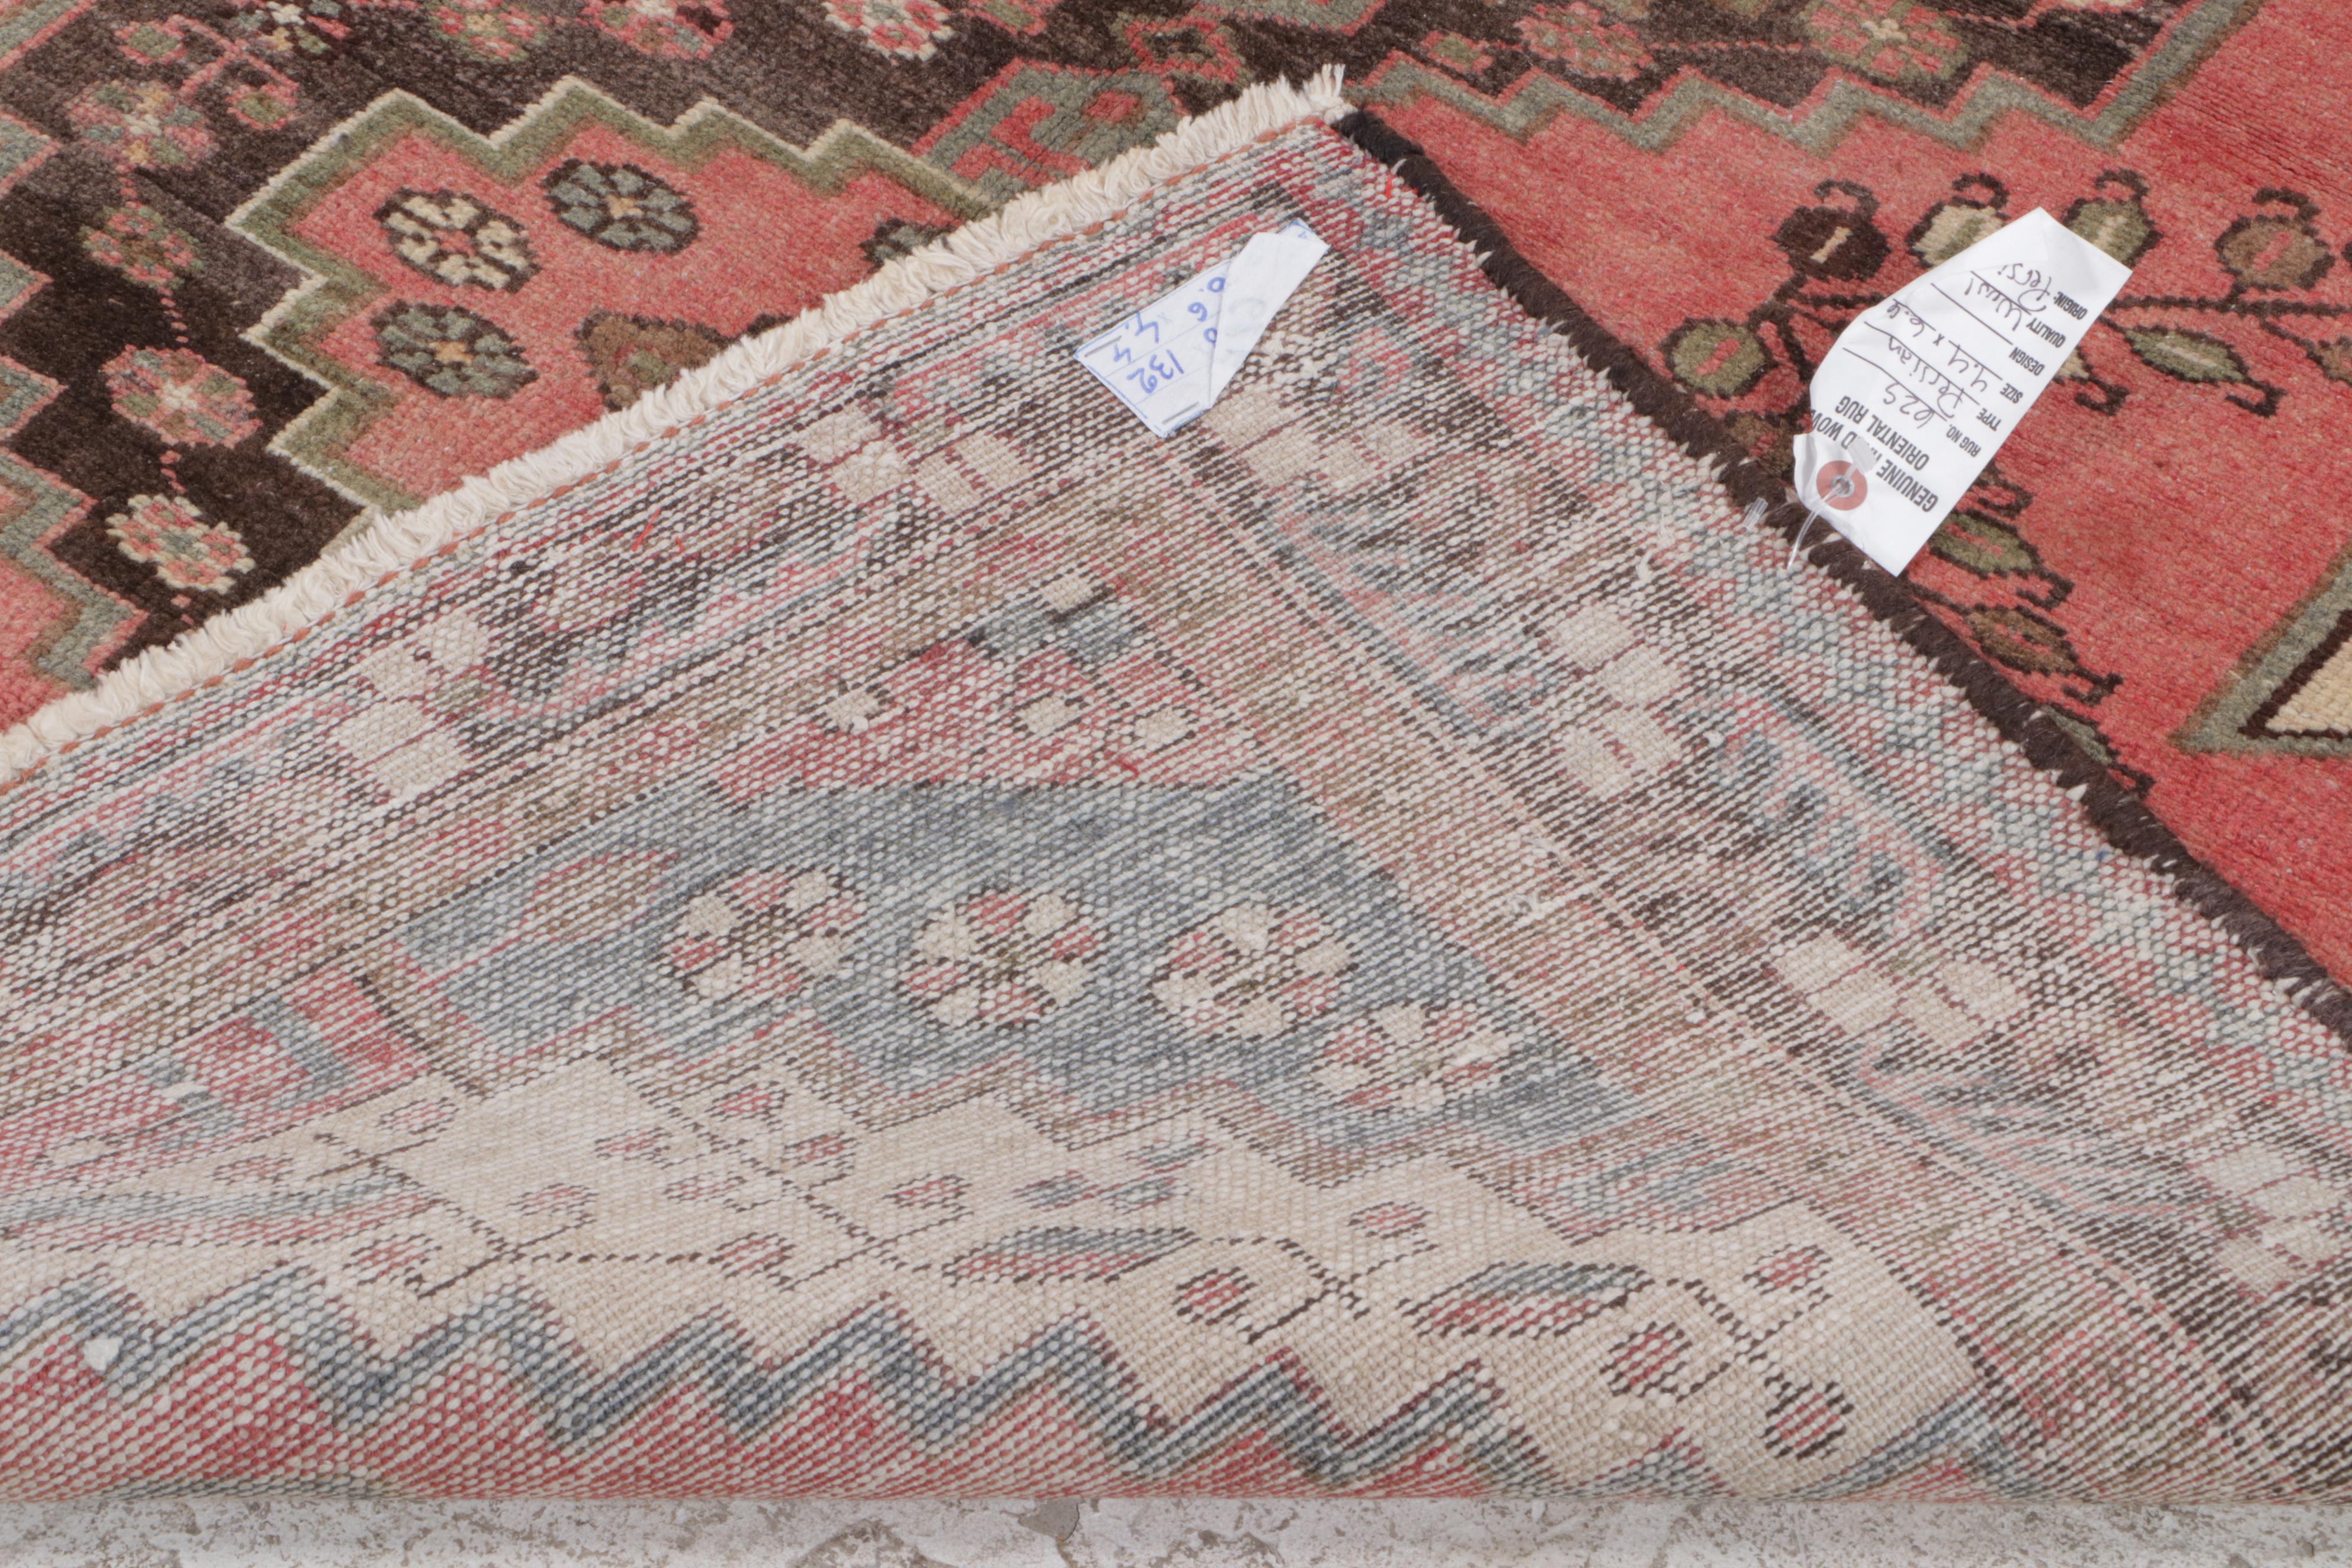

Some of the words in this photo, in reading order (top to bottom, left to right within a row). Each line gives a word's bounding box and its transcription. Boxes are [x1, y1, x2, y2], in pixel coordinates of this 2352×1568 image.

[2053, 291, 2088, 321] ORIGIN:
[2026, 318, 2066, 348] QUALITY
[2008, 347, 2045, 376] DESIGN
[1889, 336, 1964, 419] Persian
[2000, 383, 2023, 404] SIZE
[1835, 396, 1869, 424] RUG
[1976, 408, 2001, 432] TYPE
[1811, 409, 1844, 441] WOV
[1946, 424, 1963, 443] NO.
[1866, 414, 1929, 471] ORIENTAL
[1959, 436, 1981, 457] RUG
[1876, 459, 1939, 512] GENUINE
